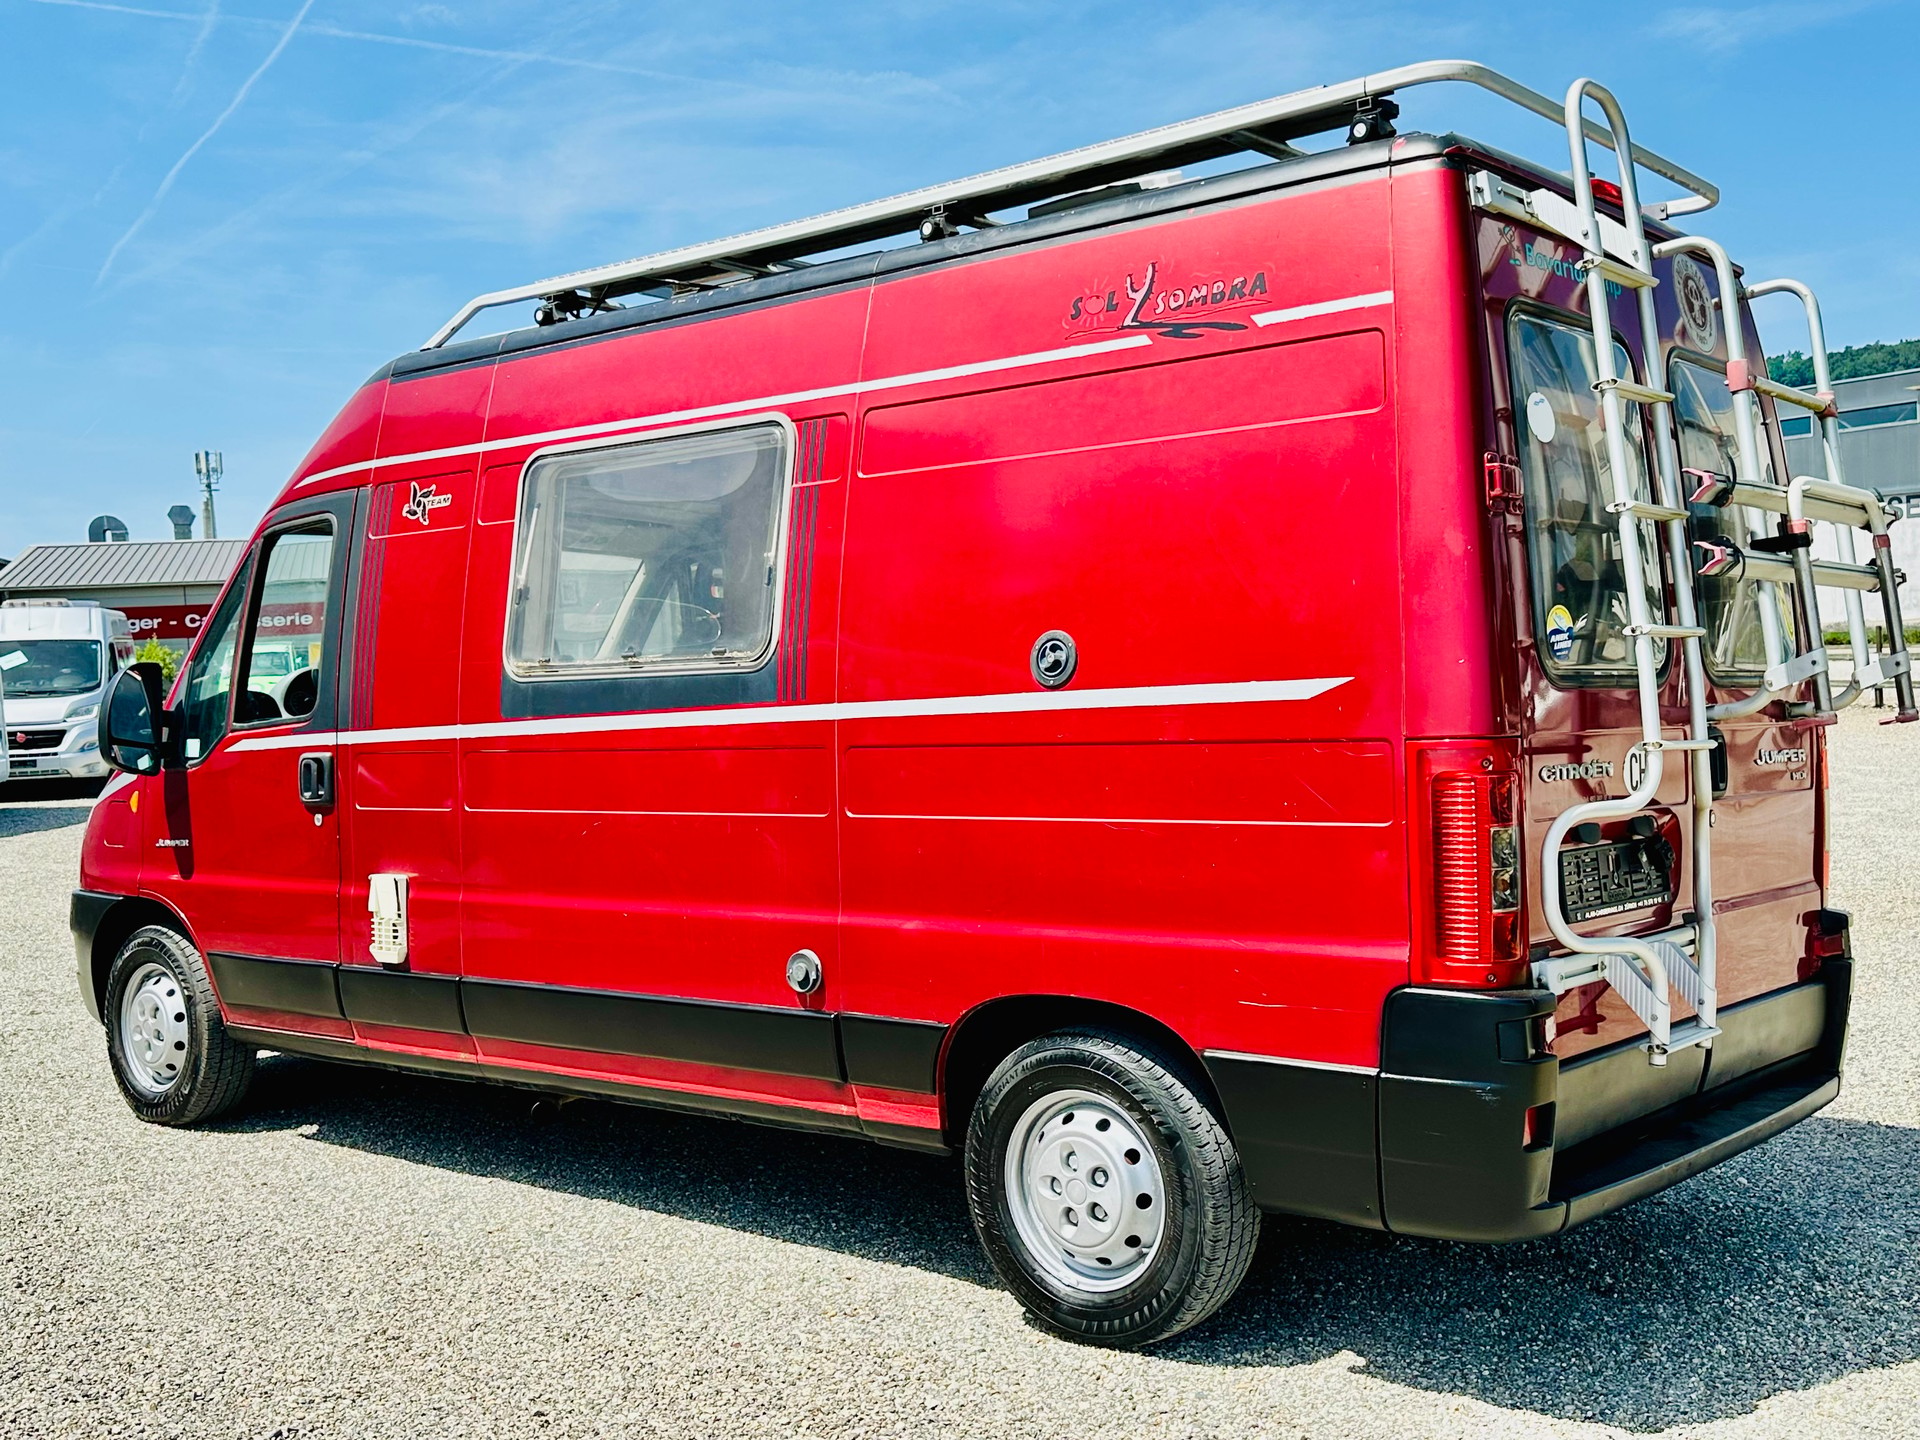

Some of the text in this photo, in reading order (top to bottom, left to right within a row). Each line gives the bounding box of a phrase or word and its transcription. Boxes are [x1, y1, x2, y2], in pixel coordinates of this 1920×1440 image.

[1070, 291, 1119, 320] SOL
[1153, 272, 1268, 316] SOMBRA
[427, 497, 450, 507] TEAM
[1753, 748, 1807, 766] JUMPER
